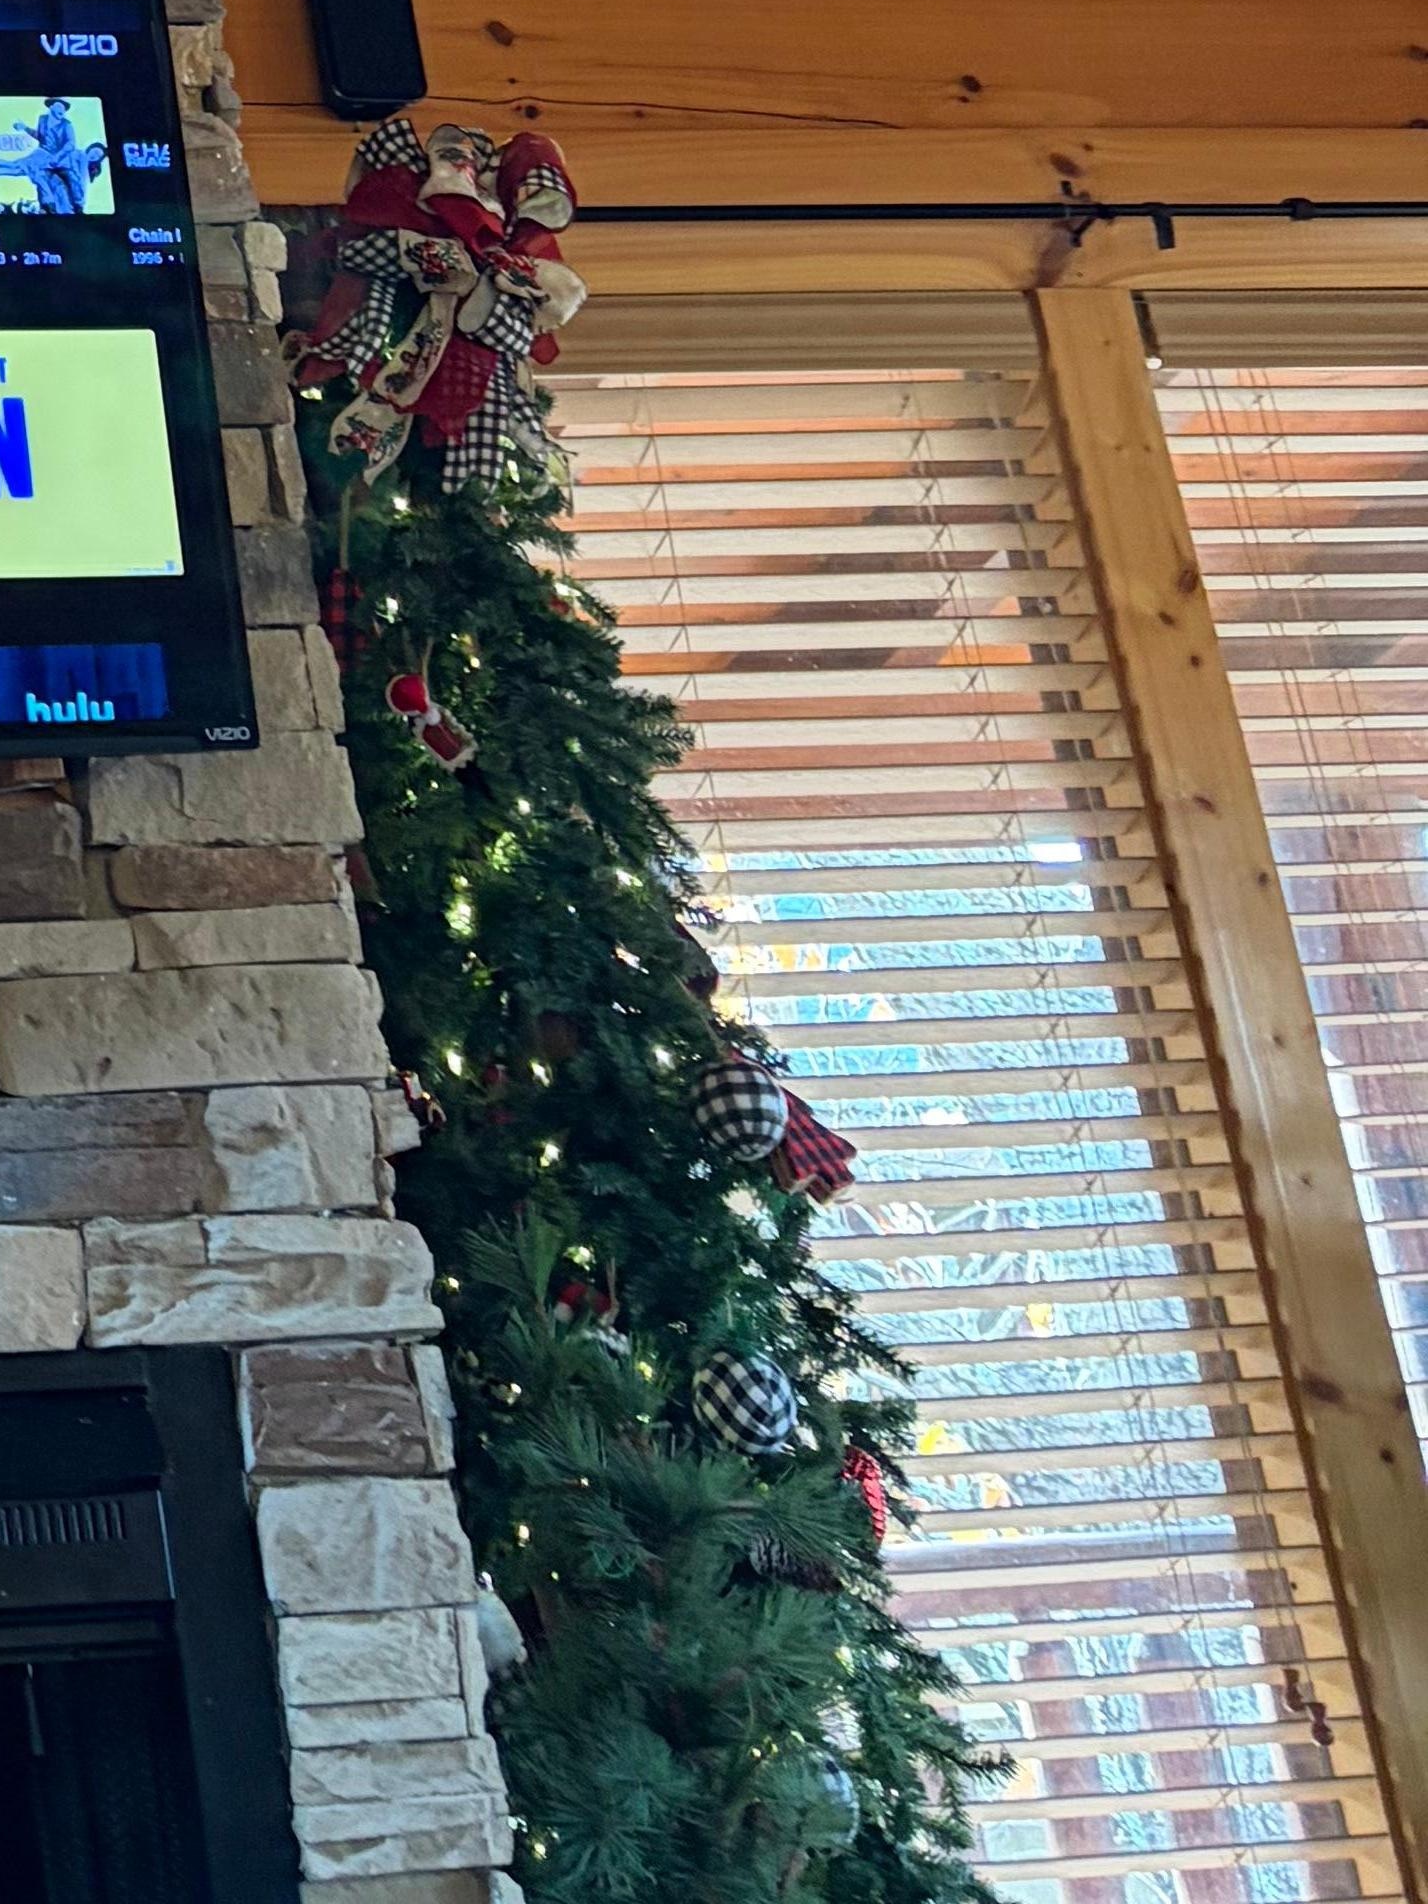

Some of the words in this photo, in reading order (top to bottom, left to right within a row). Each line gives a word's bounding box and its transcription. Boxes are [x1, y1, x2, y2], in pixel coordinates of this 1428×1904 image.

[40, 34, 118, 55] VIZIO
[128, 228, 172, 243] Chain
[26, 691, 115, 722] hulu
[205, 726, 251, 742] VIZIO
